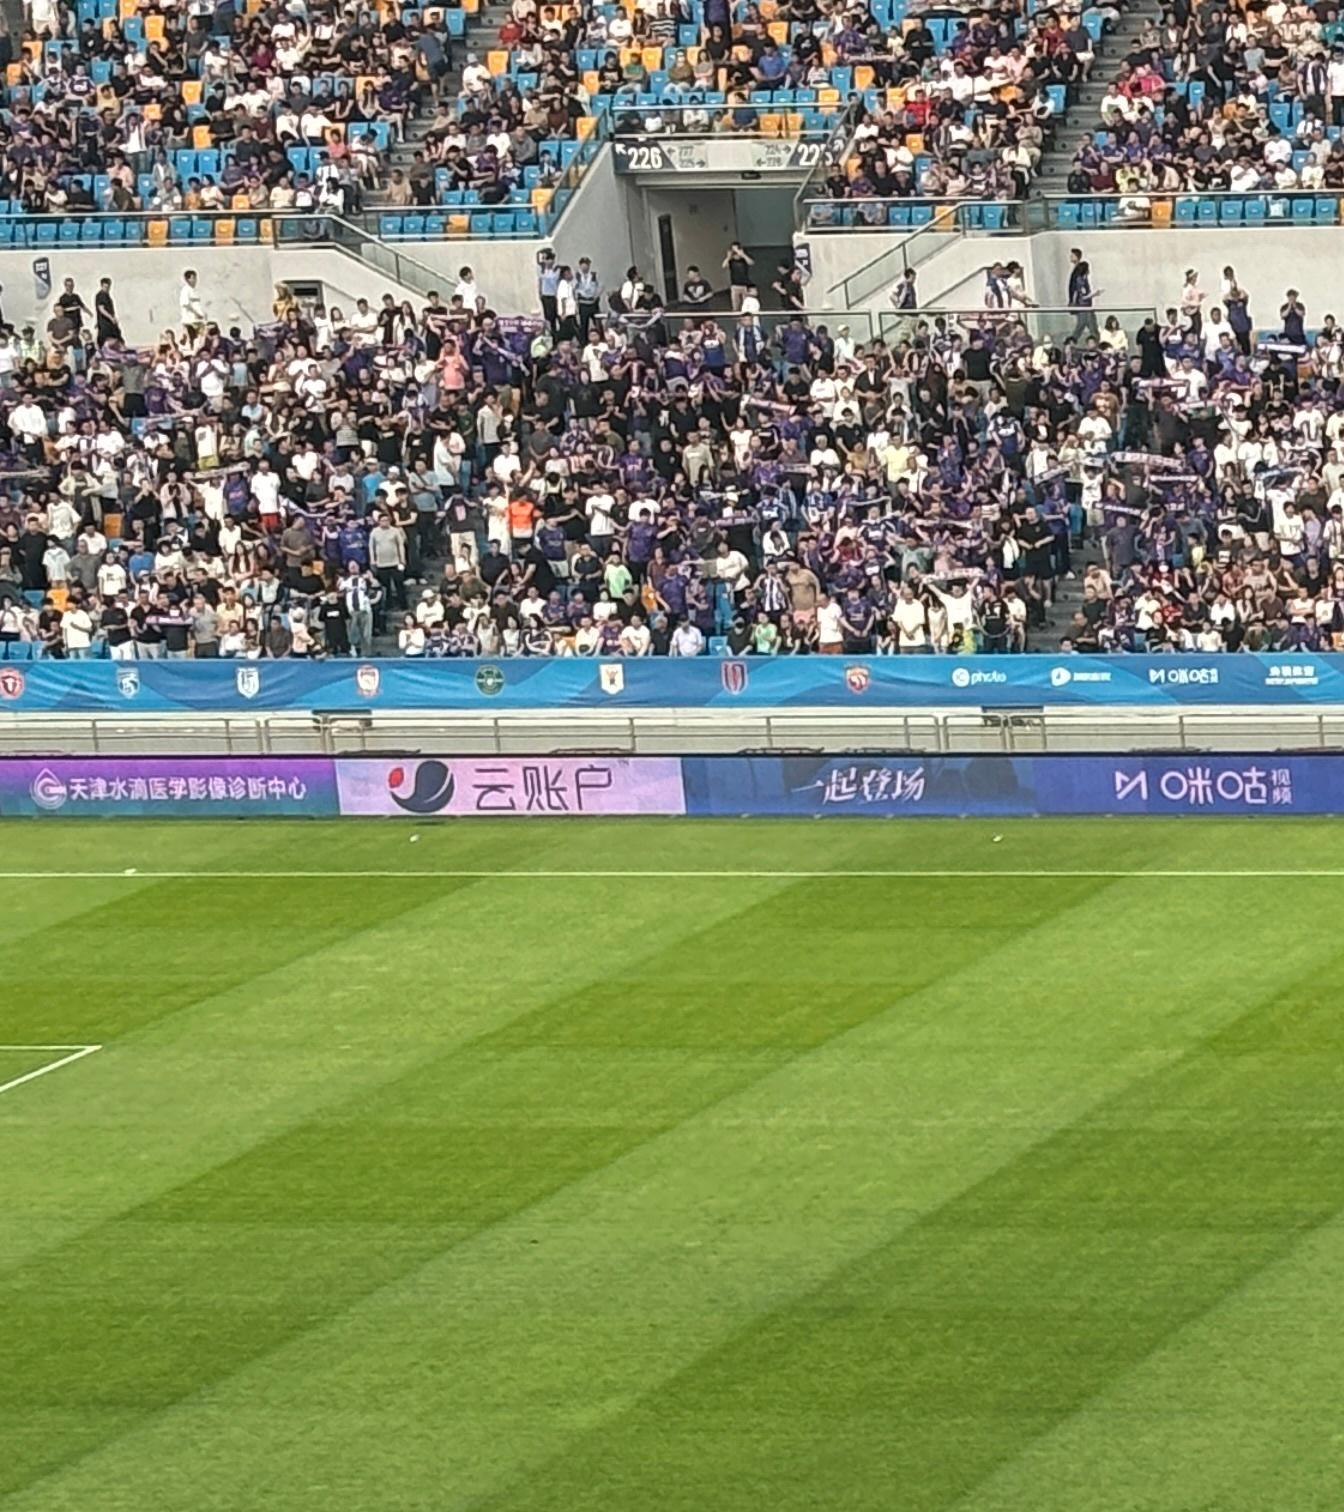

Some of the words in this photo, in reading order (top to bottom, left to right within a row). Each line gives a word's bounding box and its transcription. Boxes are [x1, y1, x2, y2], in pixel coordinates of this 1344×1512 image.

[628, 147, 663, 169] 226
[69, 776, 307, 800] 天津水滴医学影像诊断中心
[472, 766, 614, 811] 云账户
[790, 766, 926, 804] 一起登场
